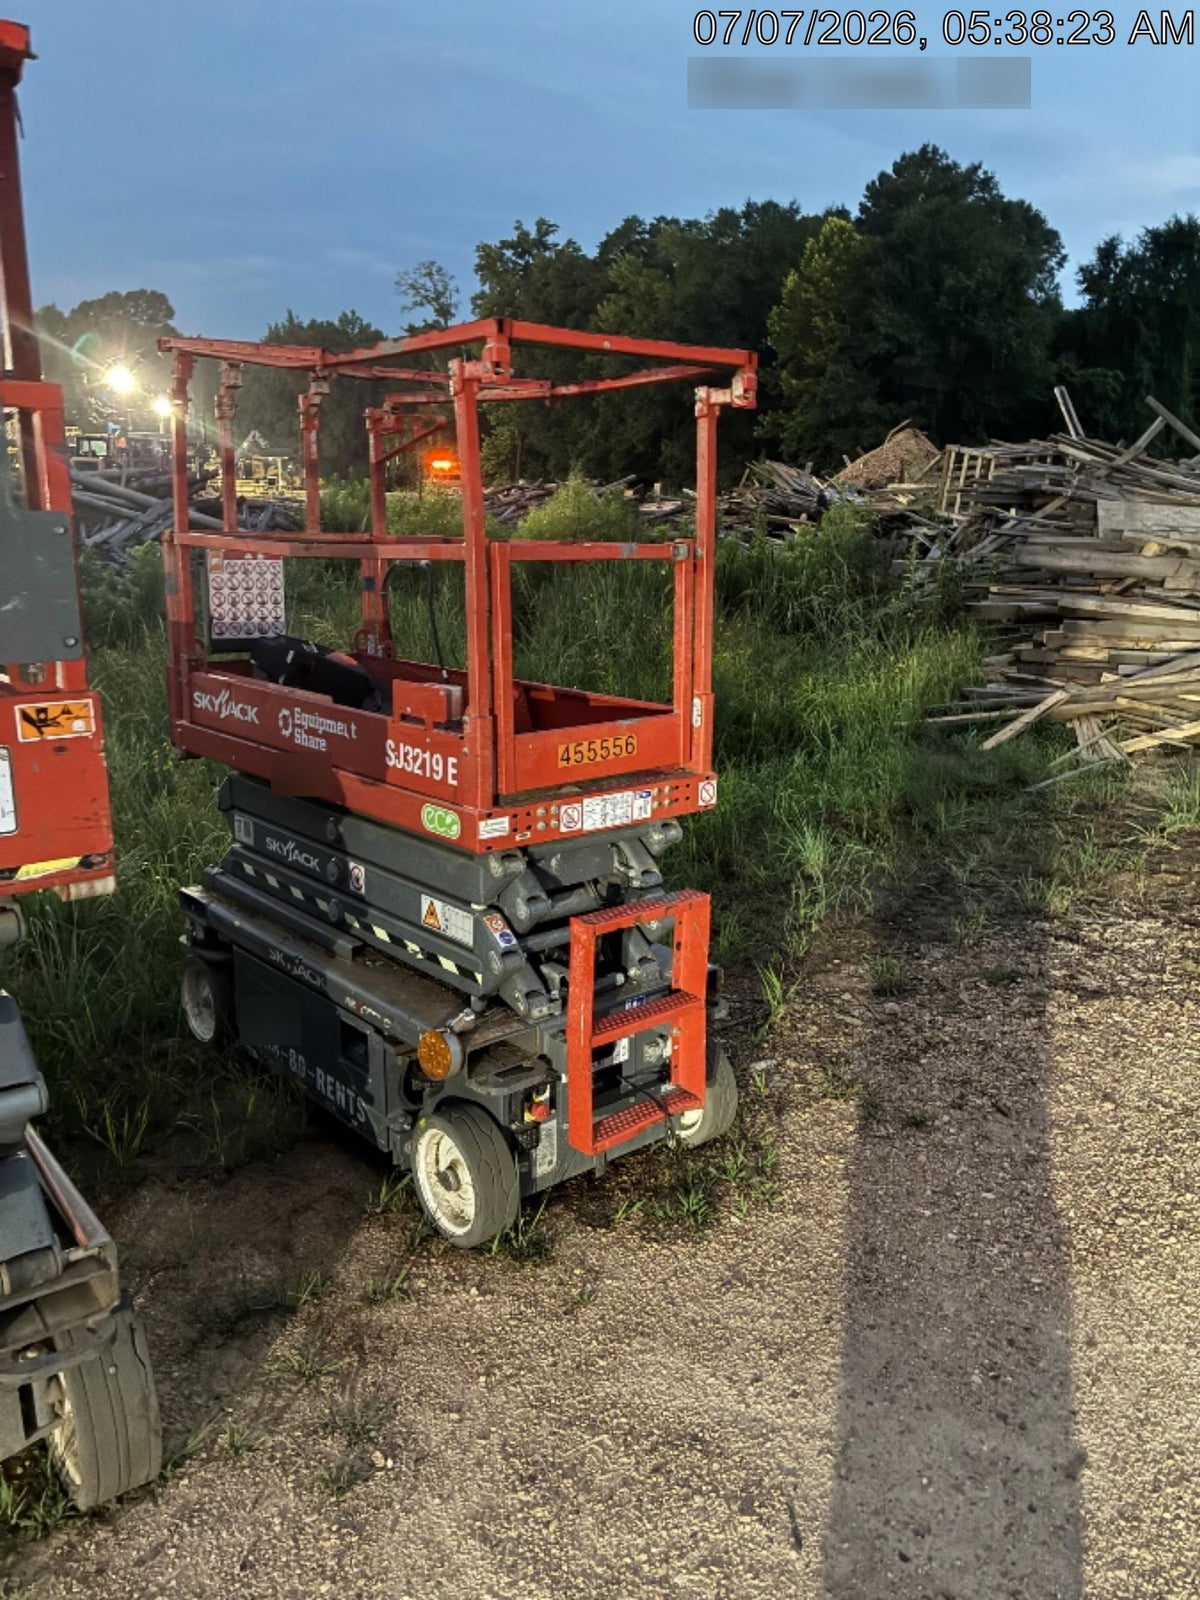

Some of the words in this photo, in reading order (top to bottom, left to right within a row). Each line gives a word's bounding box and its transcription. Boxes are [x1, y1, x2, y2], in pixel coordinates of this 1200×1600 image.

[193, 687, 260, 725] SKYJACK
[294, 727, 328, 752] Share
[559, 735, 636, 766] 455556
[385, 738, 443, 781] SJ3219
[447, 757, 459, 787] E
[265, 836, 321, 872] SKYJACK
[268, 949, 328, 988] SKJACK
